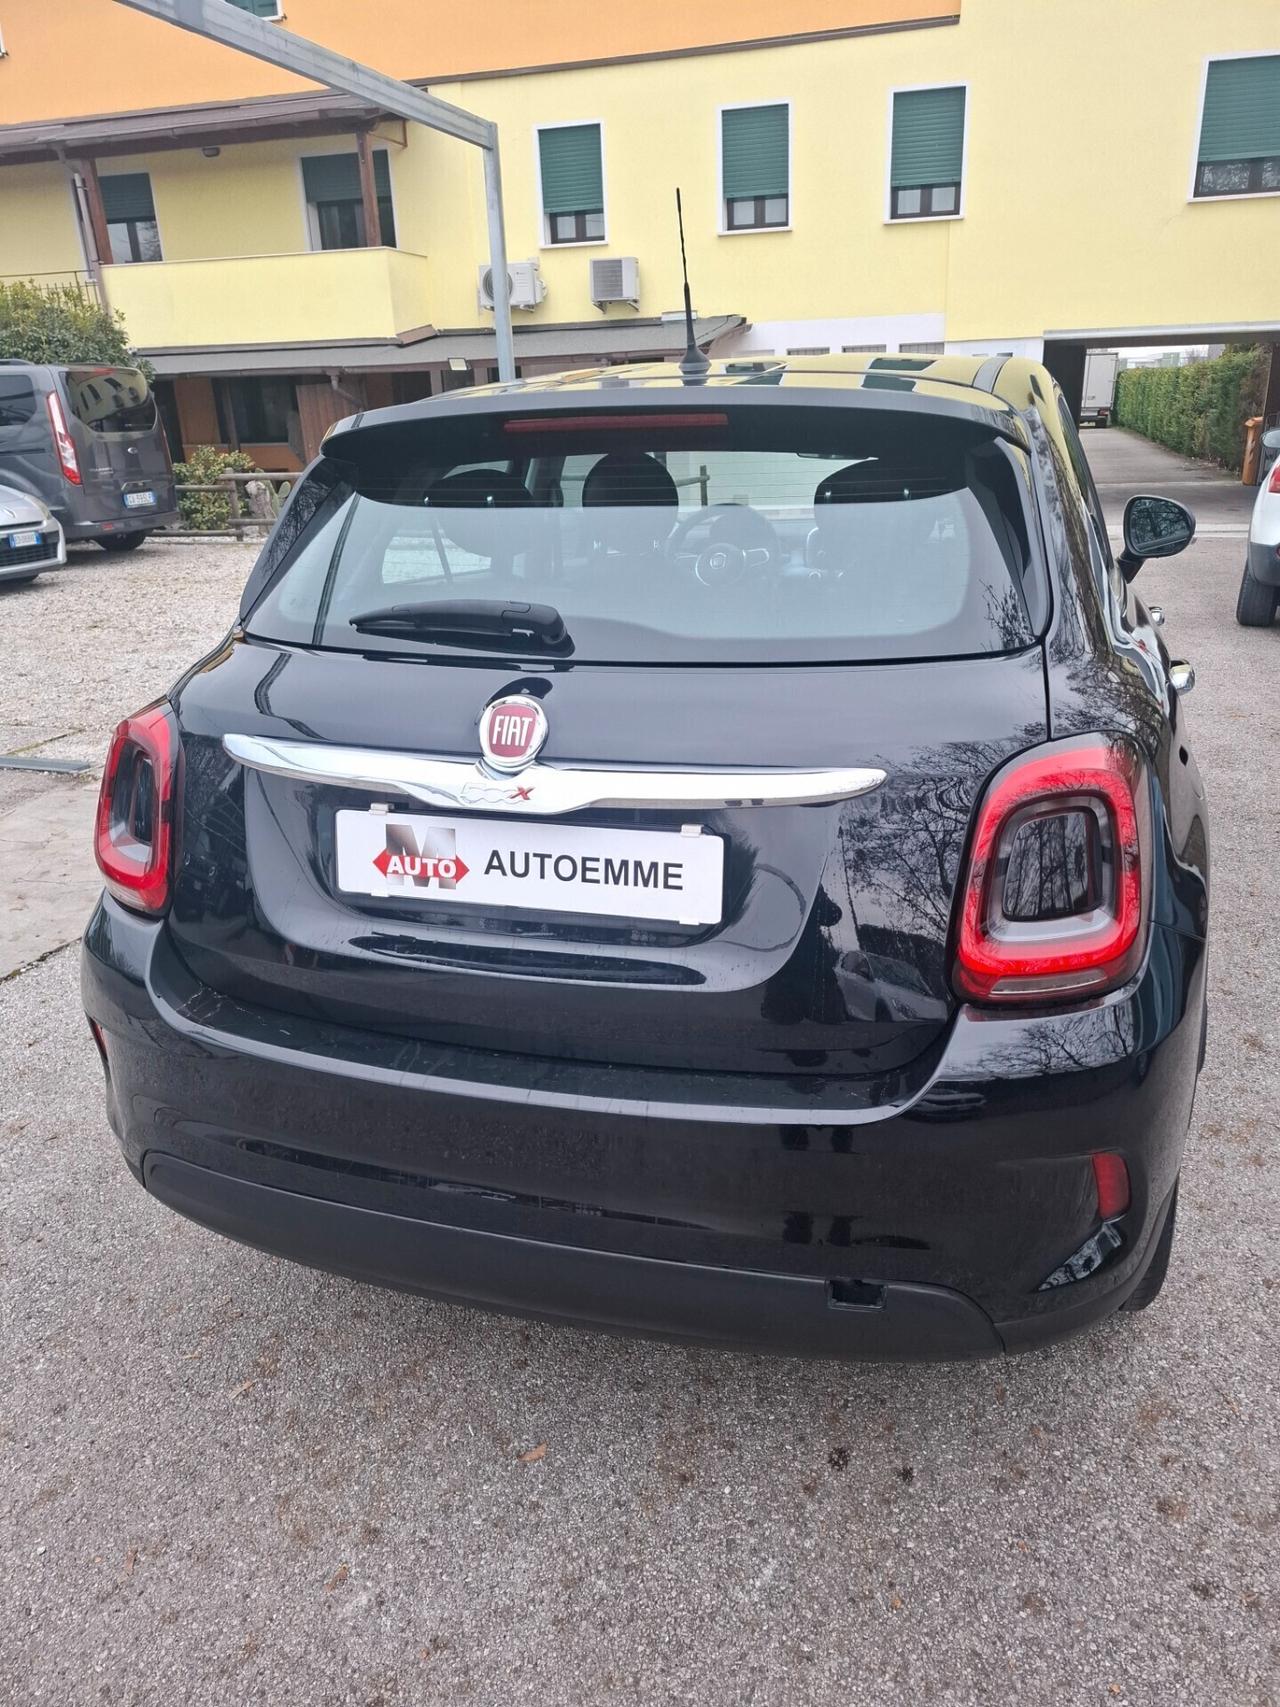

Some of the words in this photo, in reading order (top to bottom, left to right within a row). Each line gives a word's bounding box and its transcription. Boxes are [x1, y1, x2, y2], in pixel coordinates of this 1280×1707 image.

[492, 715, 533, 747] FIAT
[387, 855, 457, 879] AUTO
[484, 849, 684, 891] AUTOEMME
